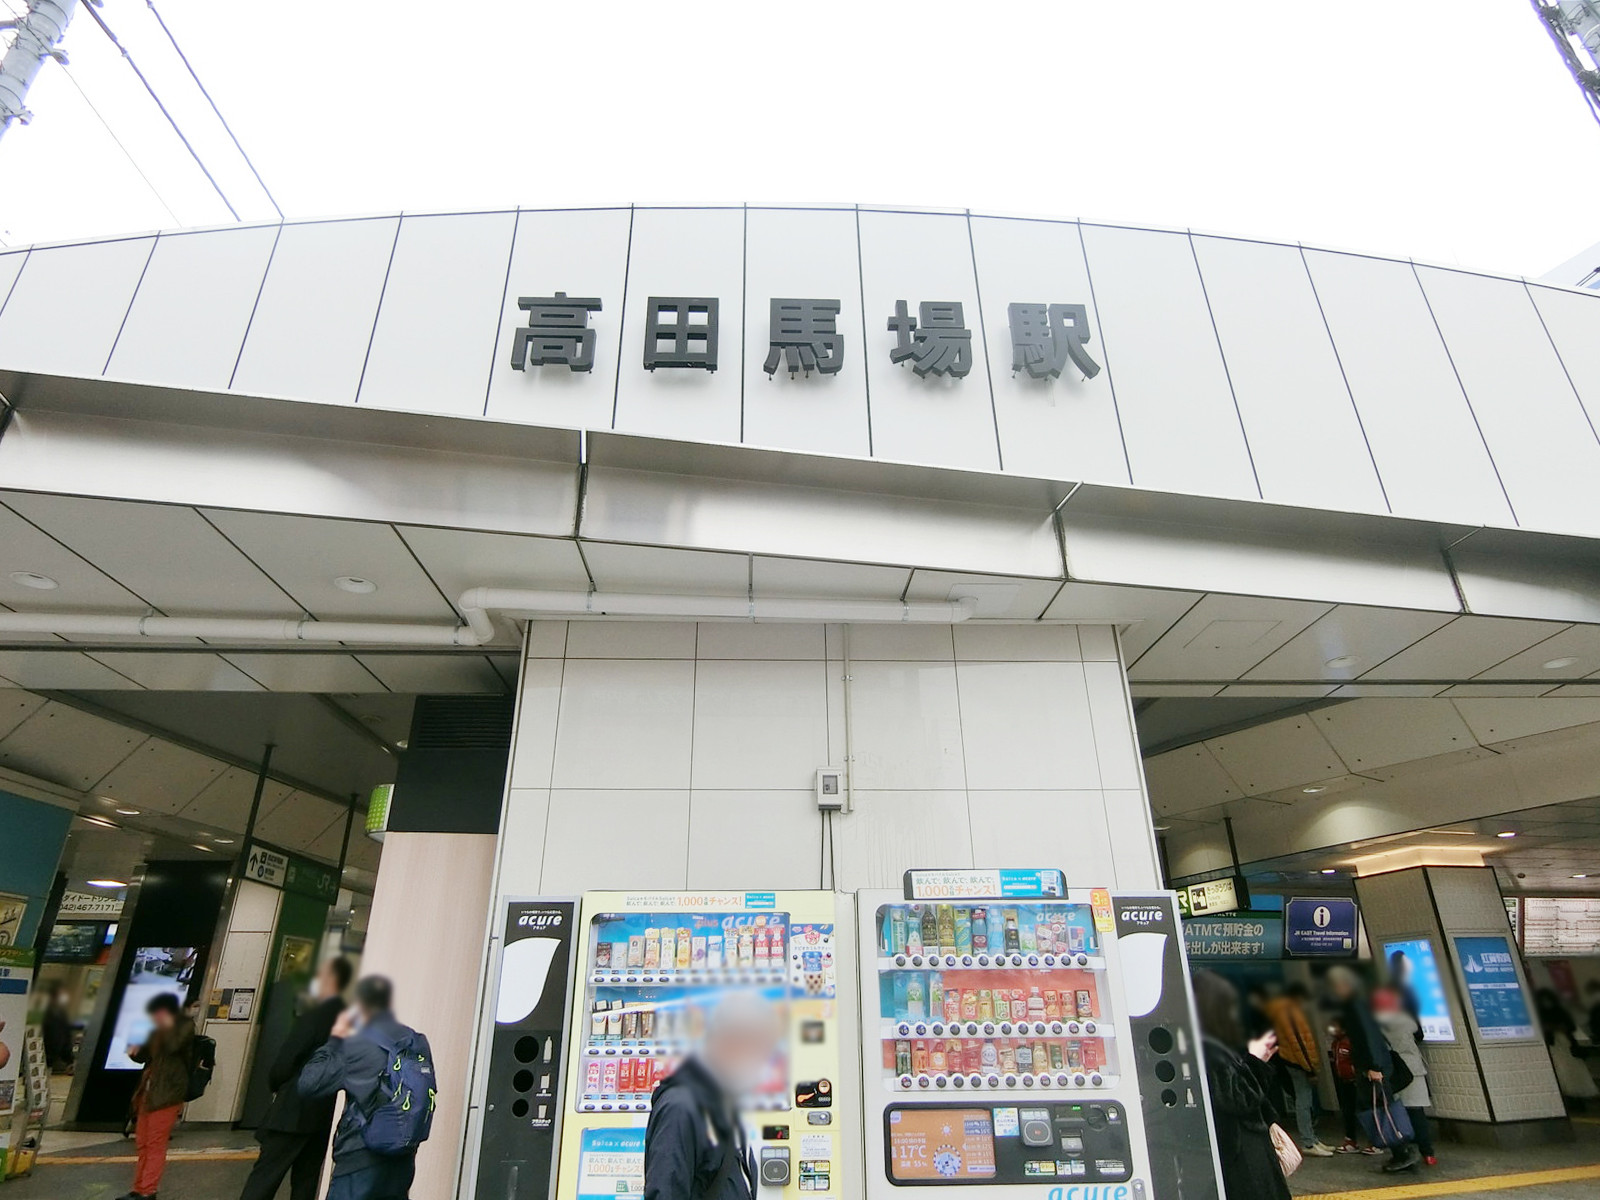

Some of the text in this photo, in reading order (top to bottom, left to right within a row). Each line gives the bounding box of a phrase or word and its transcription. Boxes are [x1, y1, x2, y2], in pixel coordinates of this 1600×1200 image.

[510, 291, 1101, 380] 高田馬場駅
[518, 915, 563, 926] acure
[721, 915, 780, 930] acue
[1121, 910, 1163, 921] acure
[1182, 922, 1264, 937] ATMで預貯金の
[1048, 1185, 1128, 1200] acure
